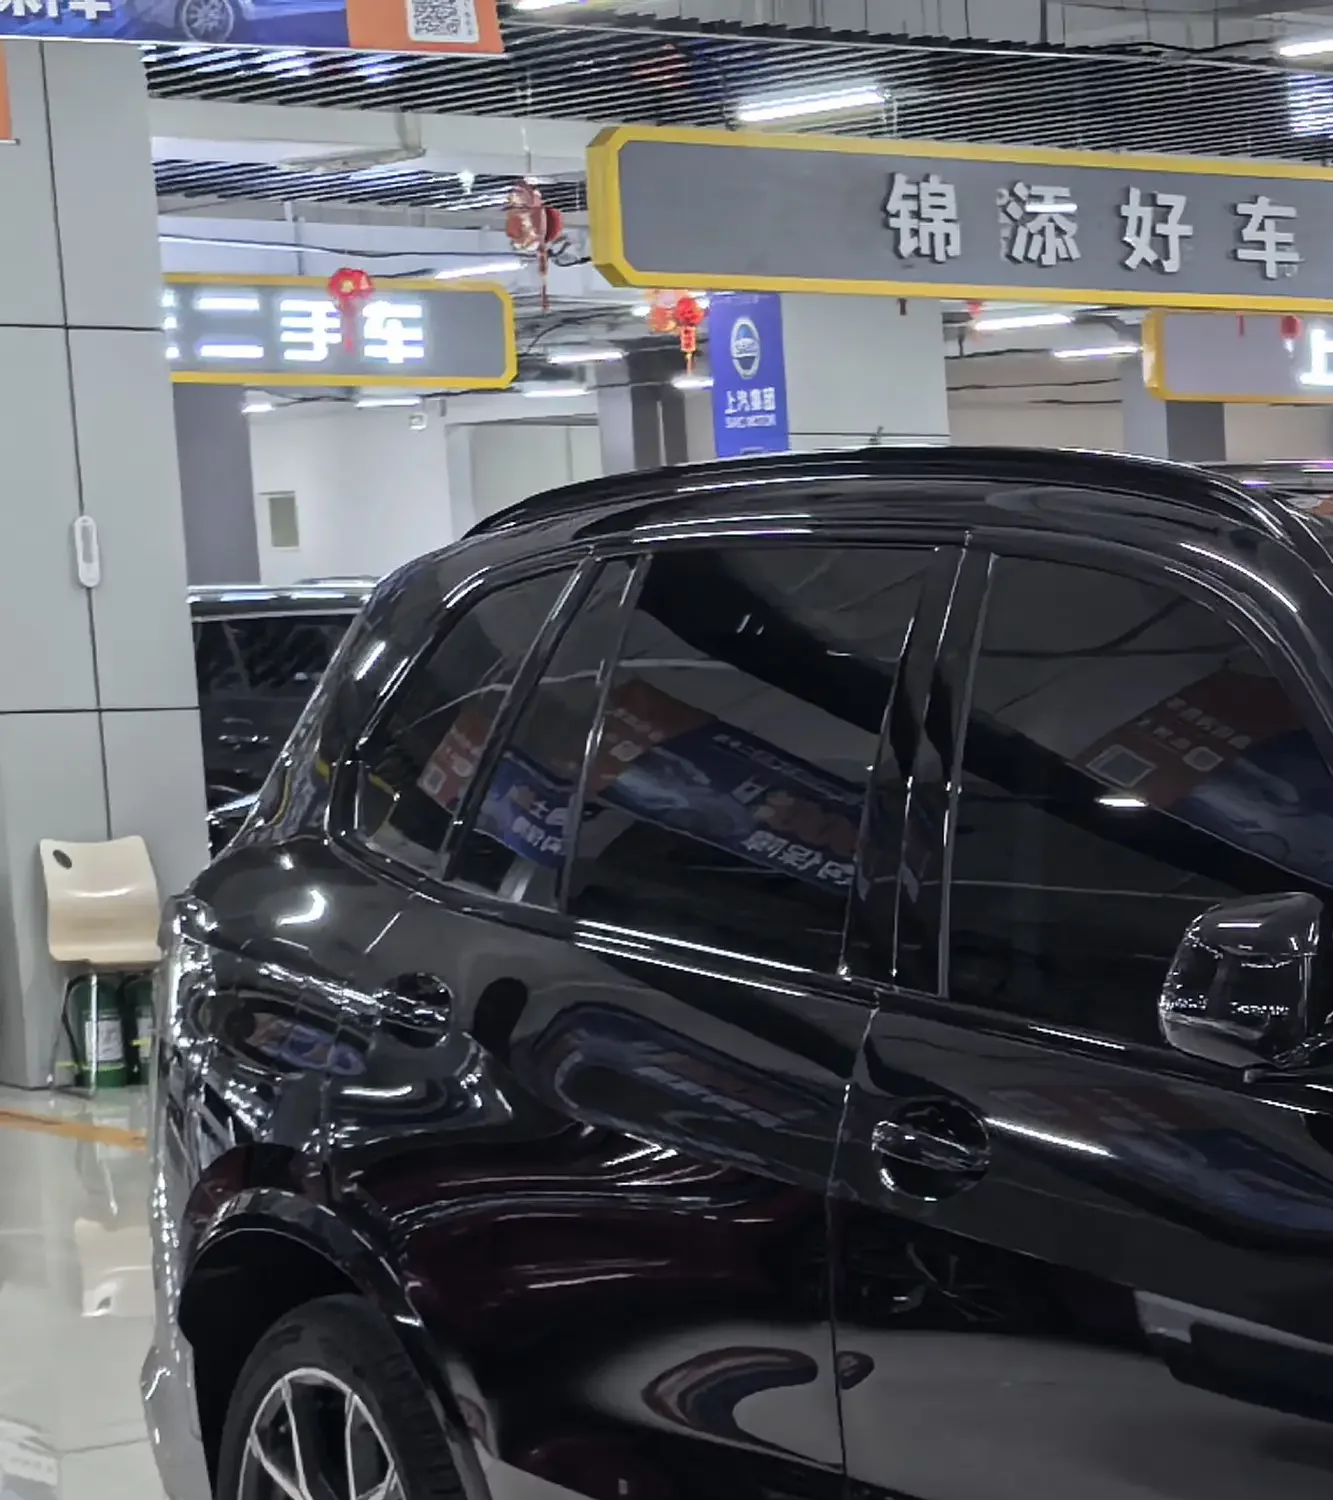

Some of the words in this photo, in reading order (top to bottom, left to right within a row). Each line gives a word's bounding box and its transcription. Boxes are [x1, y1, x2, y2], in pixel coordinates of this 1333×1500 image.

[886, 172, 1301, 279] 锦添好车
[162, 290, 425, 363] 二手车
